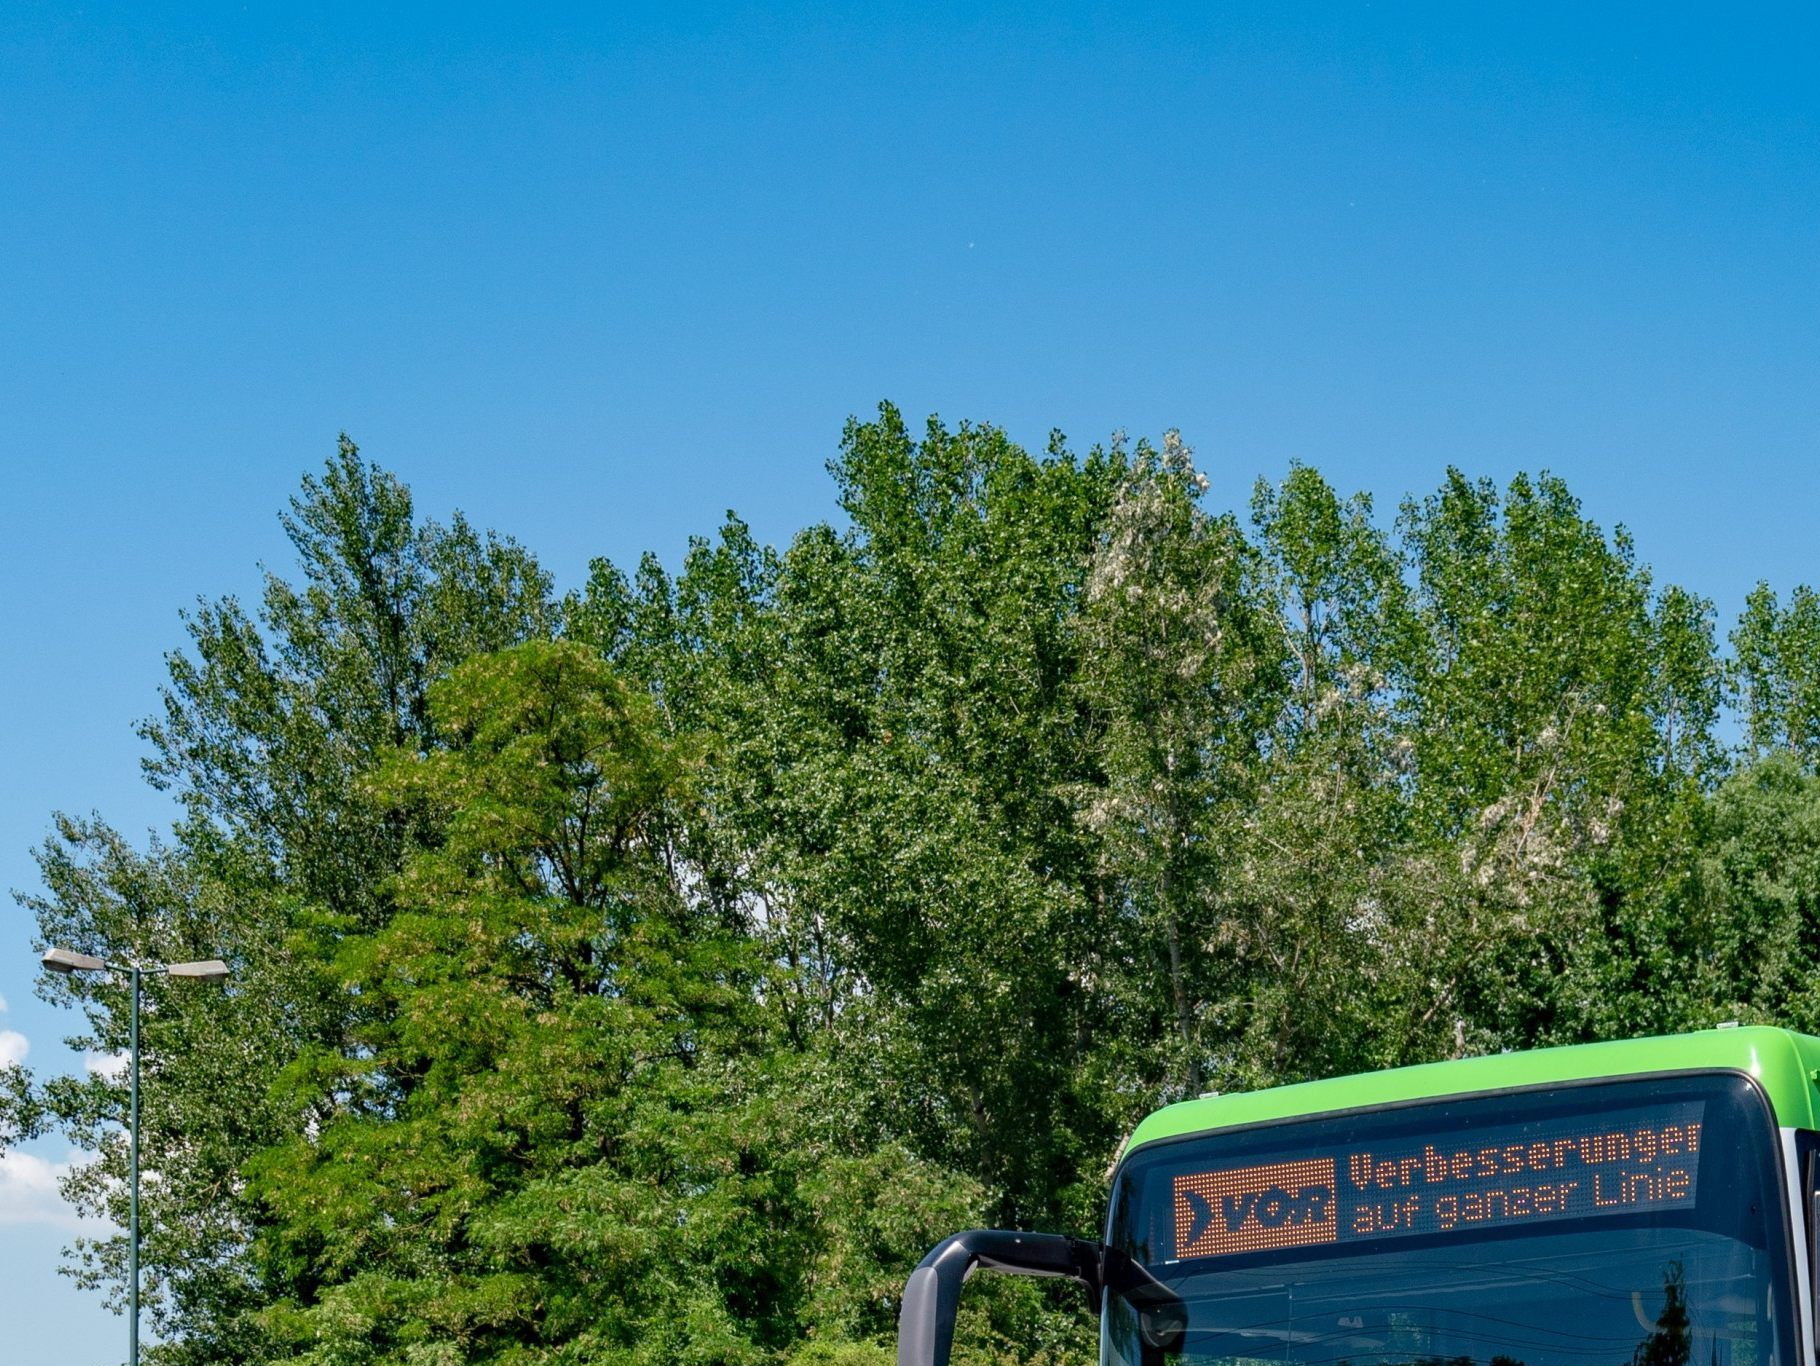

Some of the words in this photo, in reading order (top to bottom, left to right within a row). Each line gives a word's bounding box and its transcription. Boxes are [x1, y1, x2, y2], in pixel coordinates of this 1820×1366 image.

[1219, 1184, 1331, 1233] VOR
[1352, 1195, 1420, 1232] auf
[1436, 1182, 1578, 1229] ganzer
[1595, 1167, 1689, 1206] Linie
